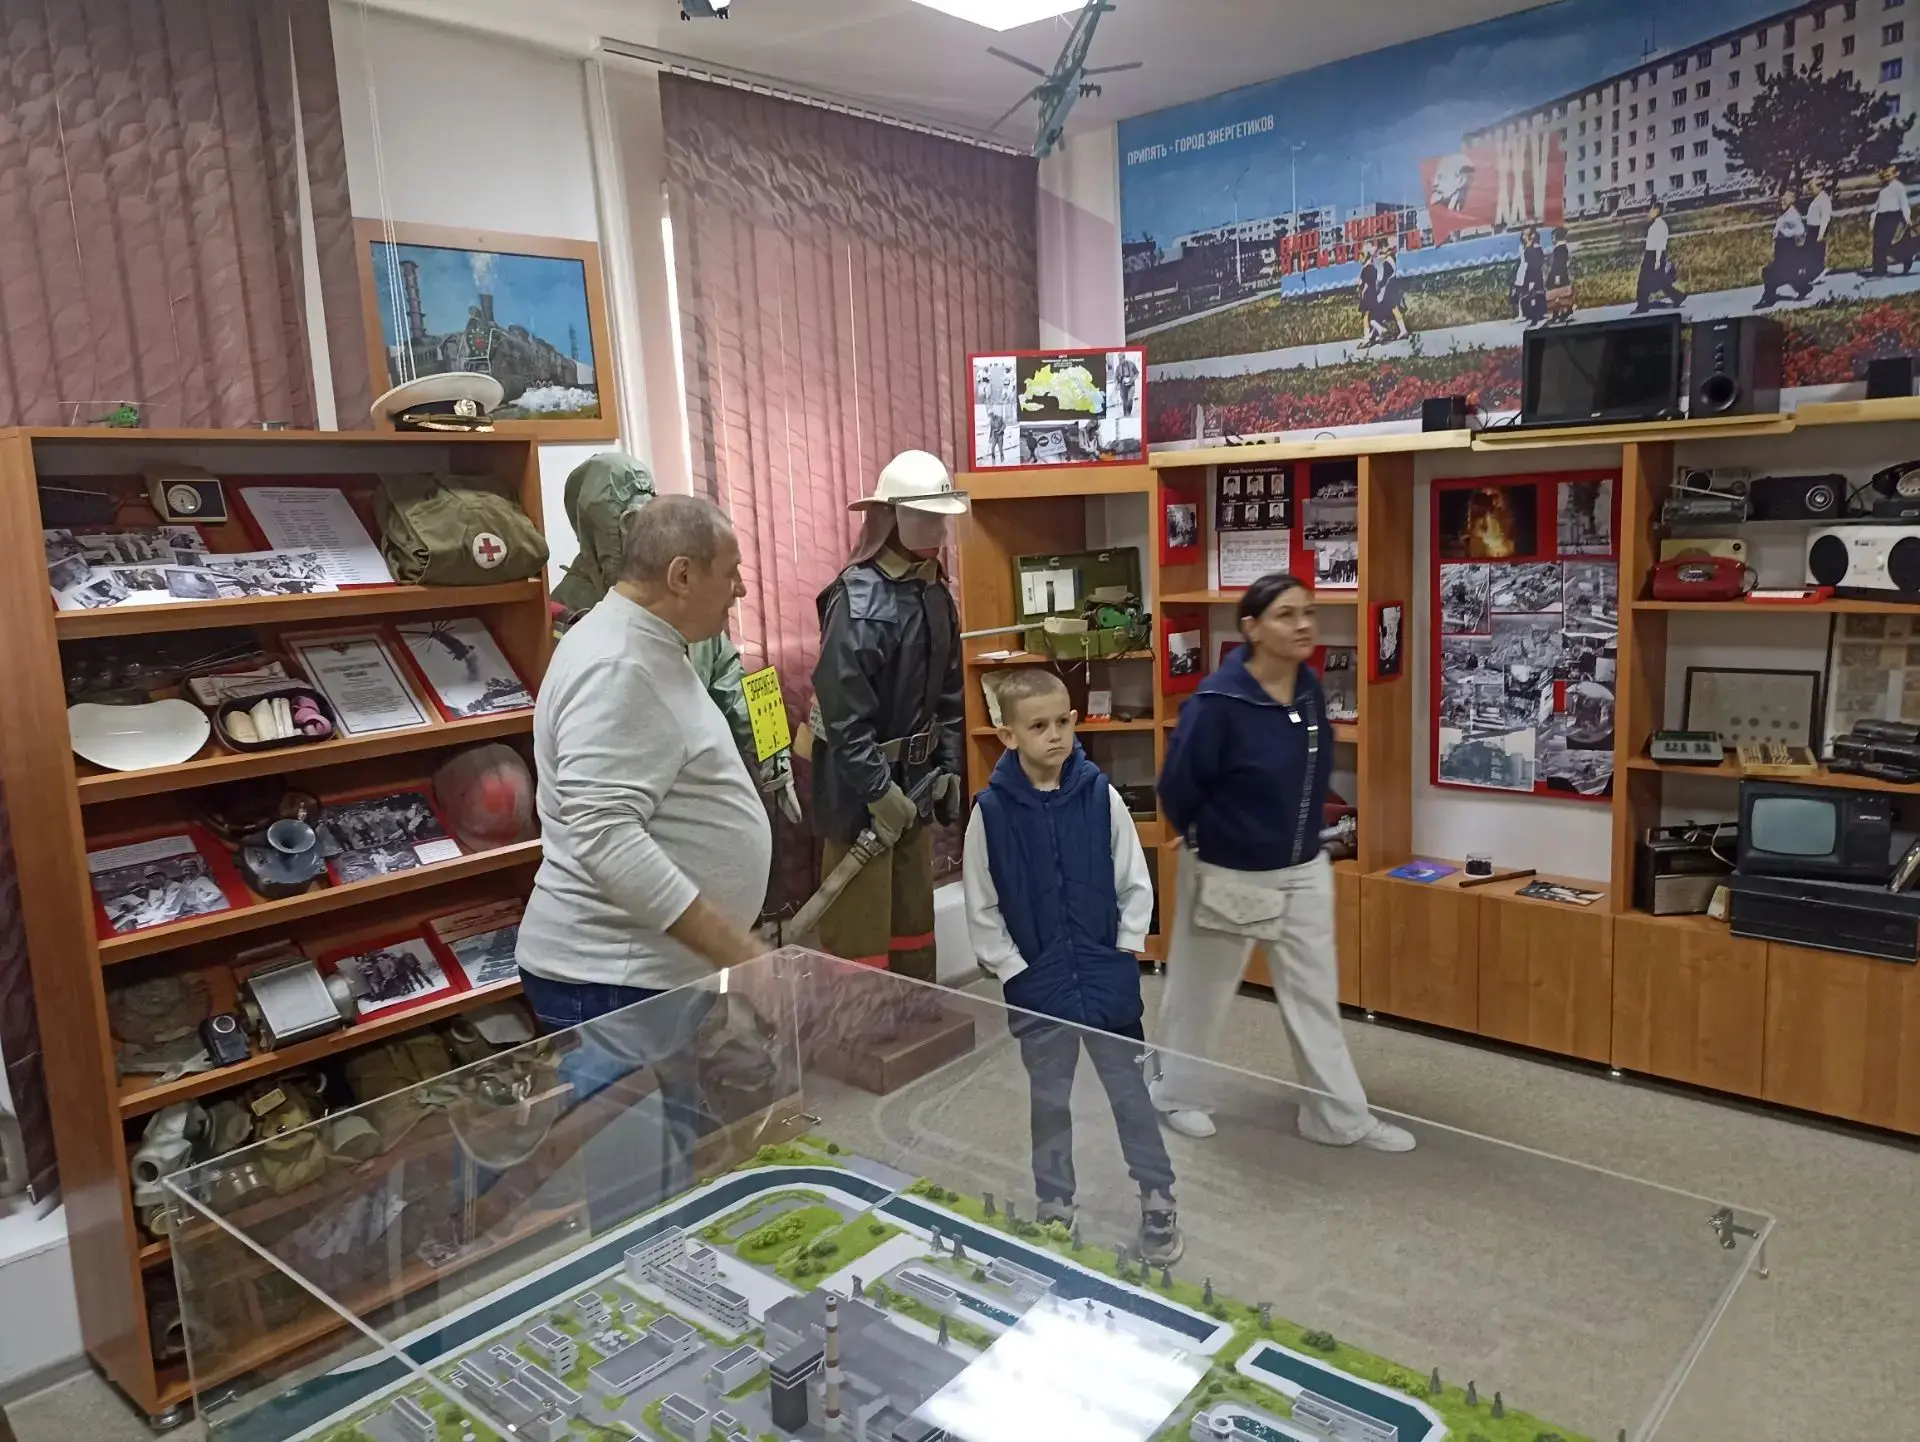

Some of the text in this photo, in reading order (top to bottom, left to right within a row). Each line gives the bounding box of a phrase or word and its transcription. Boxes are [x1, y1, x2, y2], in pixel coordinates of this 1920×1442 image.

[1127, 144, 1168, 166] ПРИПЯТЬ
[1175, 132, 1205, 153] ГОРОД
[1207, 114, 1275, 146] ЭНЕРГЕТИКОВ
